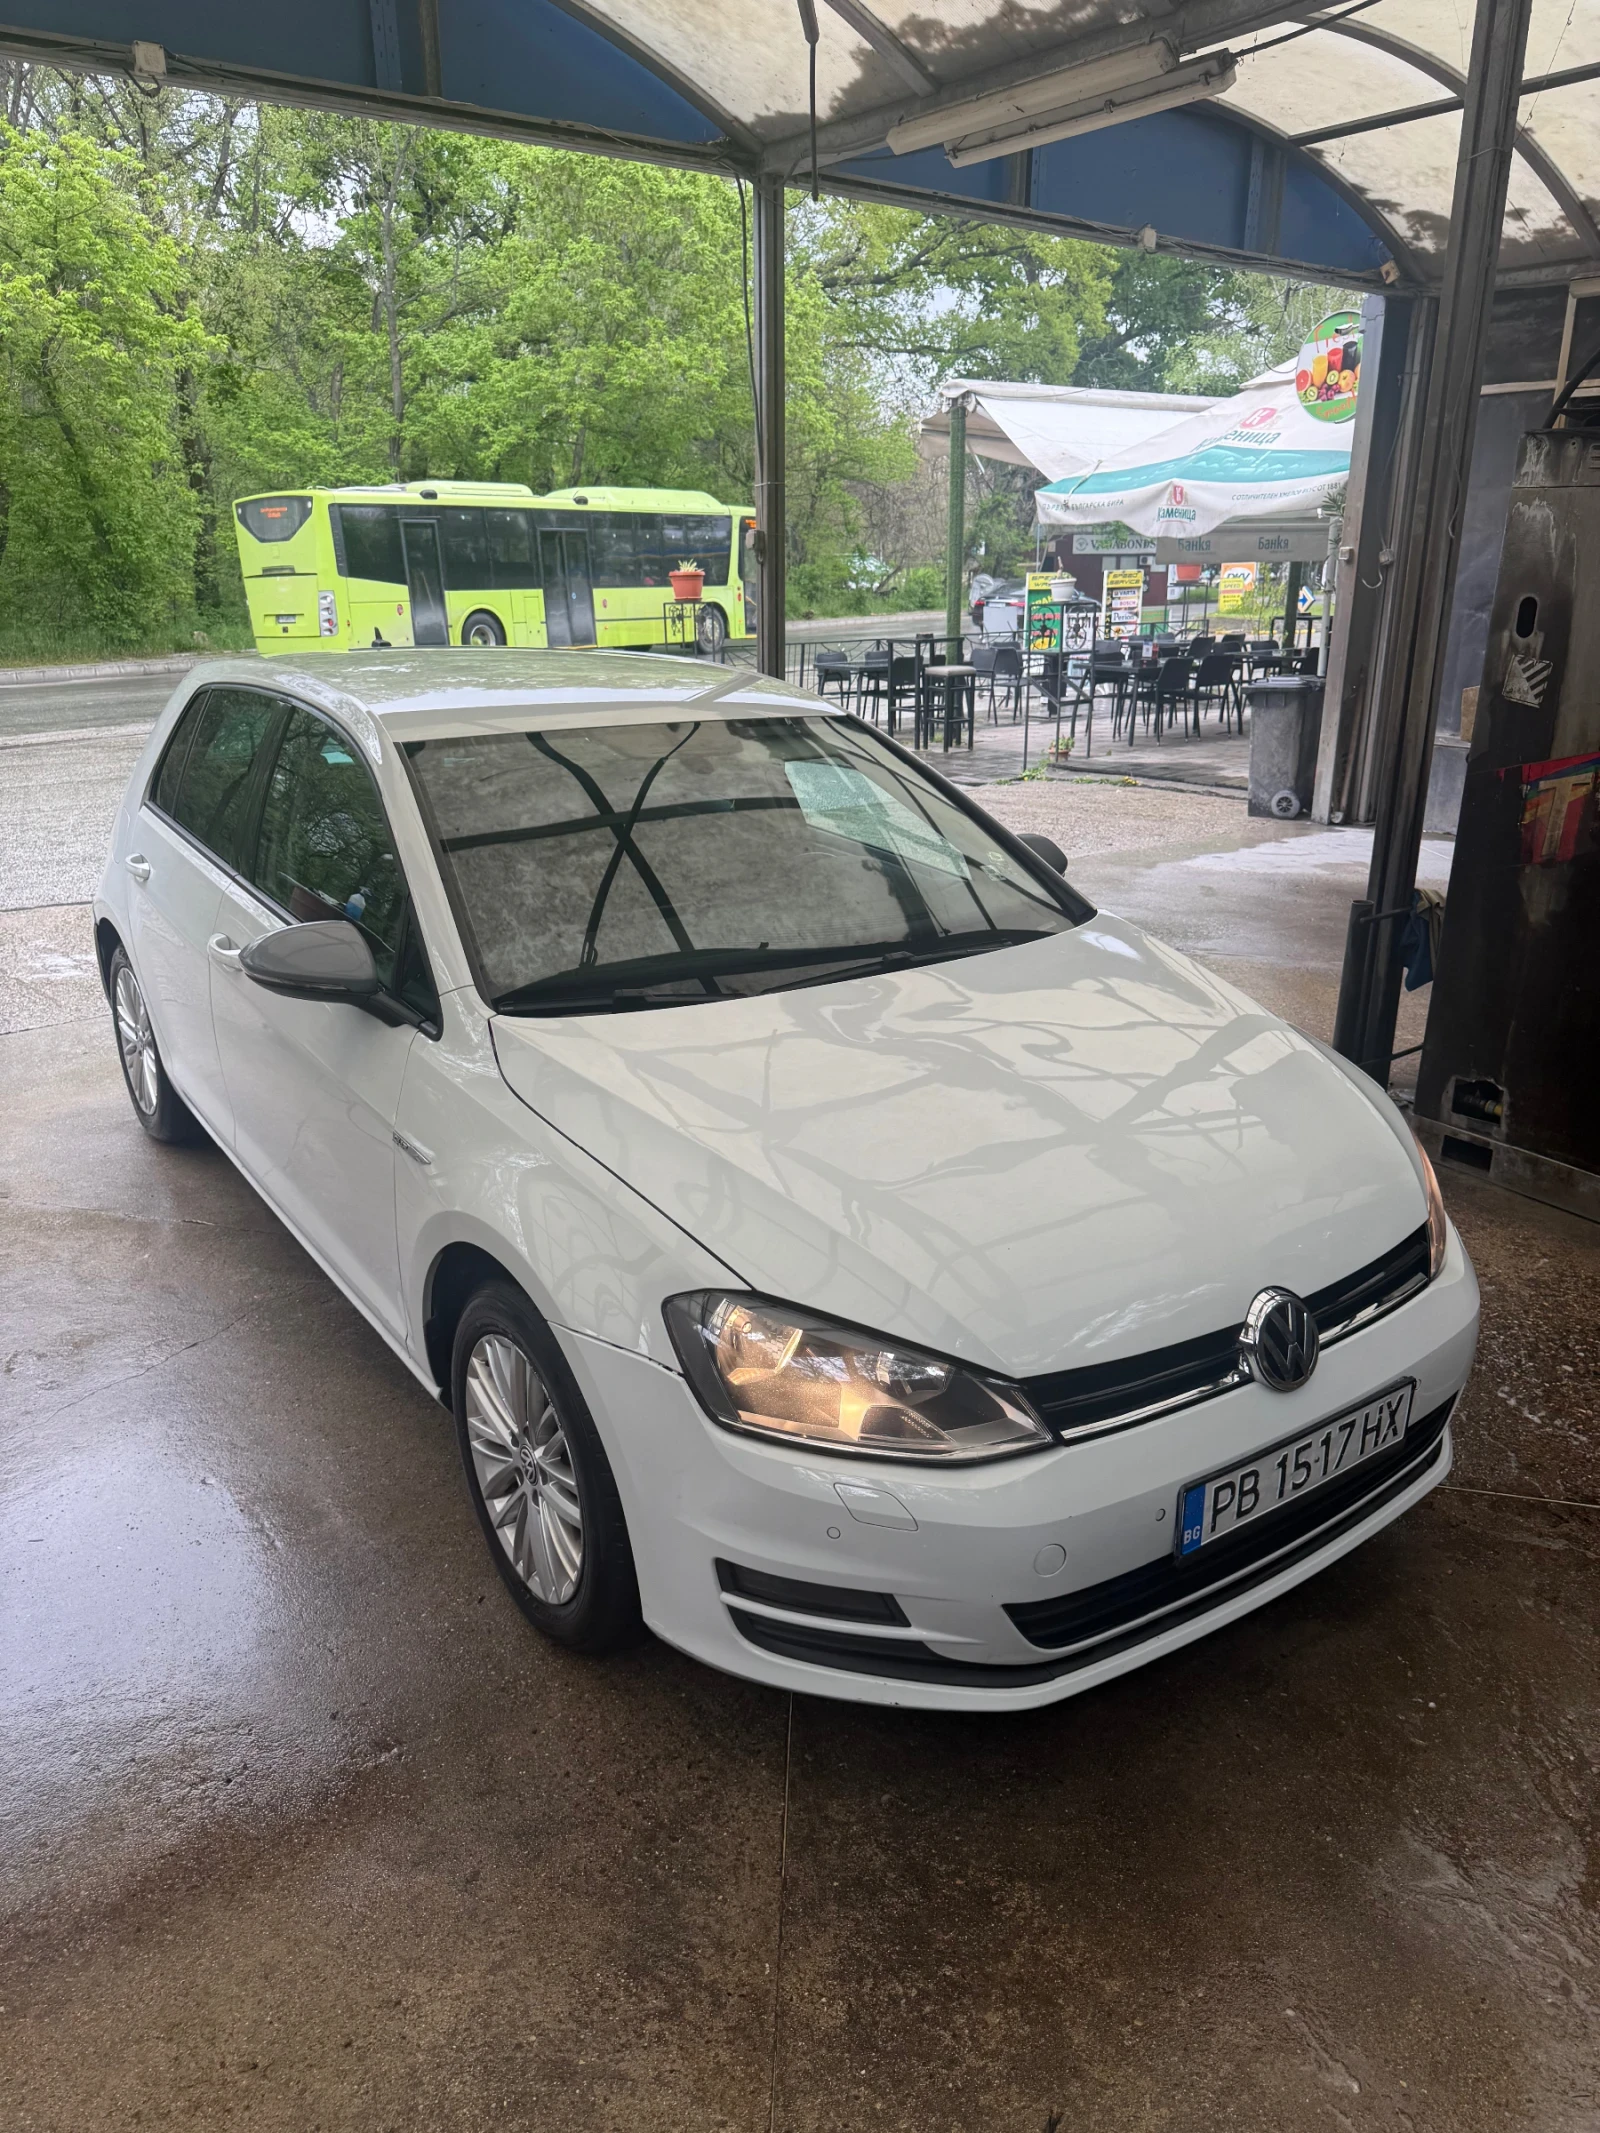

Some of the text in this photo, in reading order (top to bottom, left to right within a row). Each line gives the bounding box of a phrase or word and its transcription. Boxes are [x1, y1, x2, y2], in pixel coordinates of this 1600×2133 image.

[1156, 506, 1197, 522] Каменица
[1091, 538, 1156, 550] VABONDS
[1177, 537, 1211, 552] Банкя
[1258, 535, 1289, 550] Банкя
[1210, 1392, 1404, 1533] PB 1517 HX
[1184, 1525, 1200, 1544] BG
